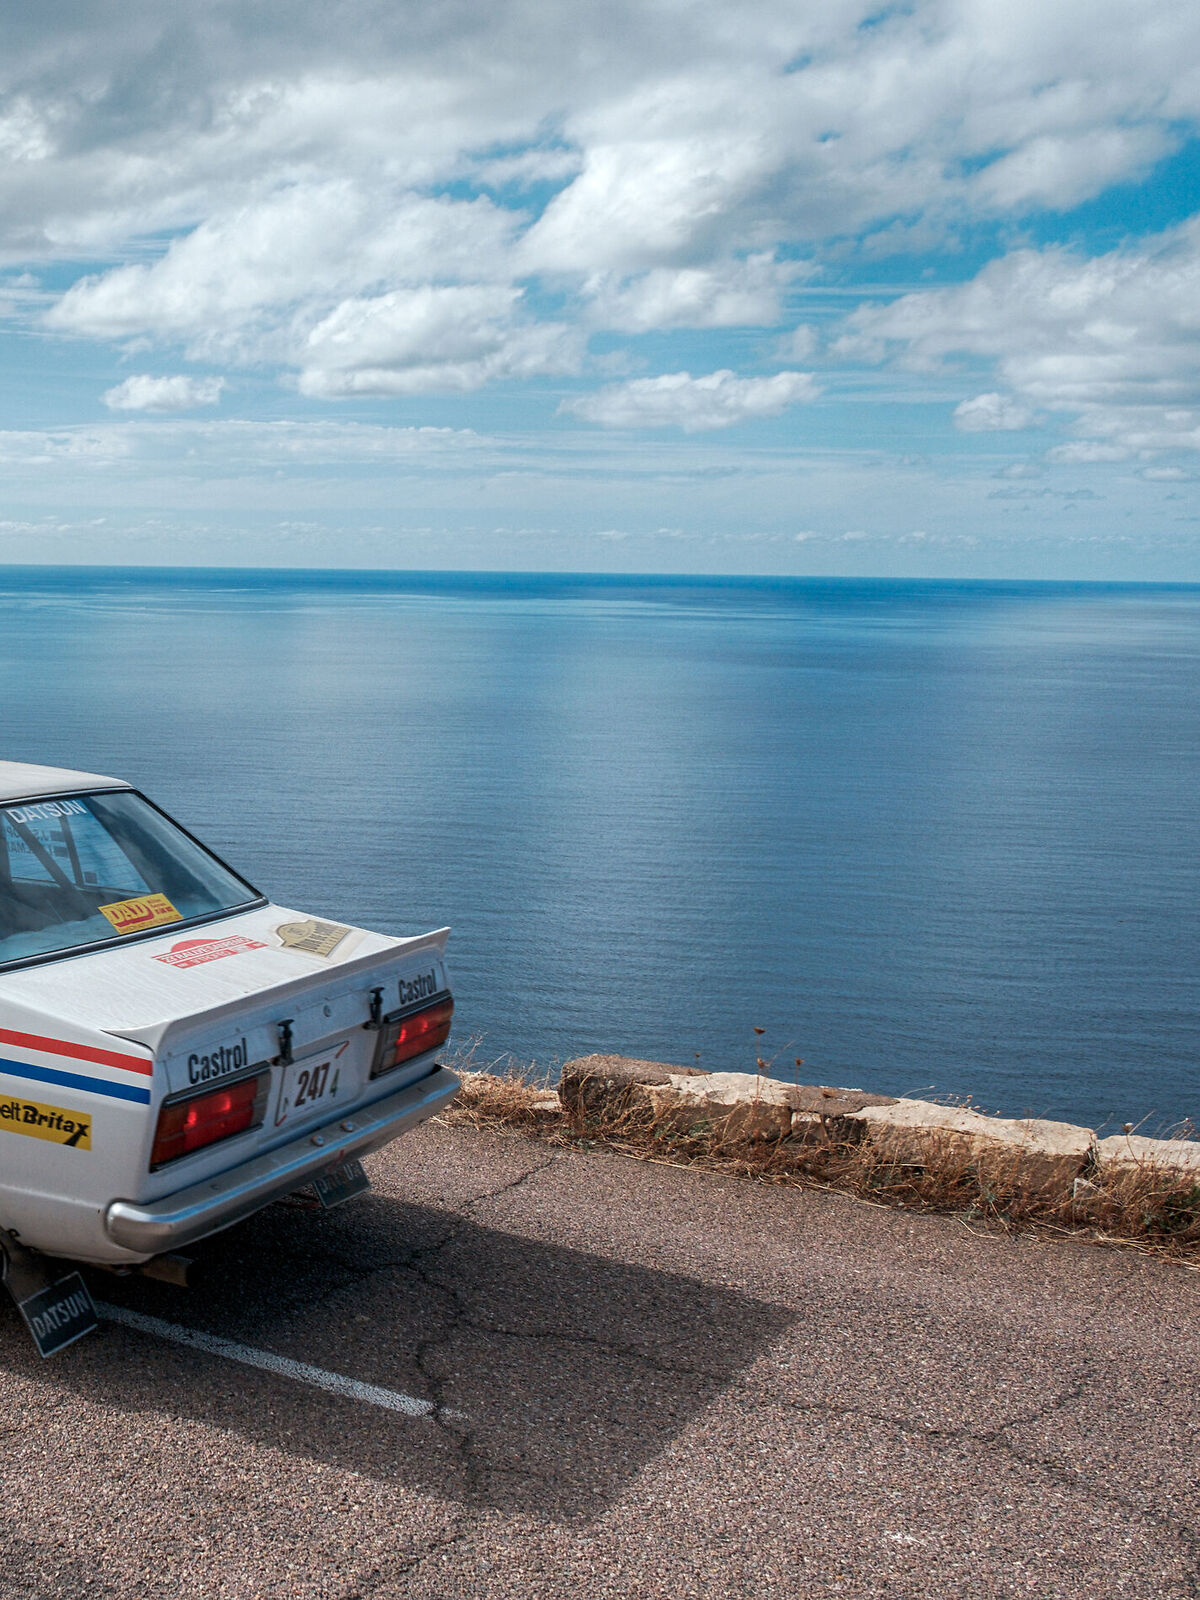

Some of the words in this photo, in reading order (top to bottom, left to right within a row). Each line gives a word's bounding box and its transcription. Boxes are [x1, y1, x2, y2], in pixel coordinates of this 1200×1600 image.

[6, 800, 87, 824] DATSUN
[101, 901, 154, 927] DAD
[399, 968, 437, 1005] Castrol
[188, 1037, 248, 1084] Castrol
[295, 1062, 331, 1107] 247
[23, 1105, 89, 1147] Britax
[32, 1290, 90, 1338] DATSUN
